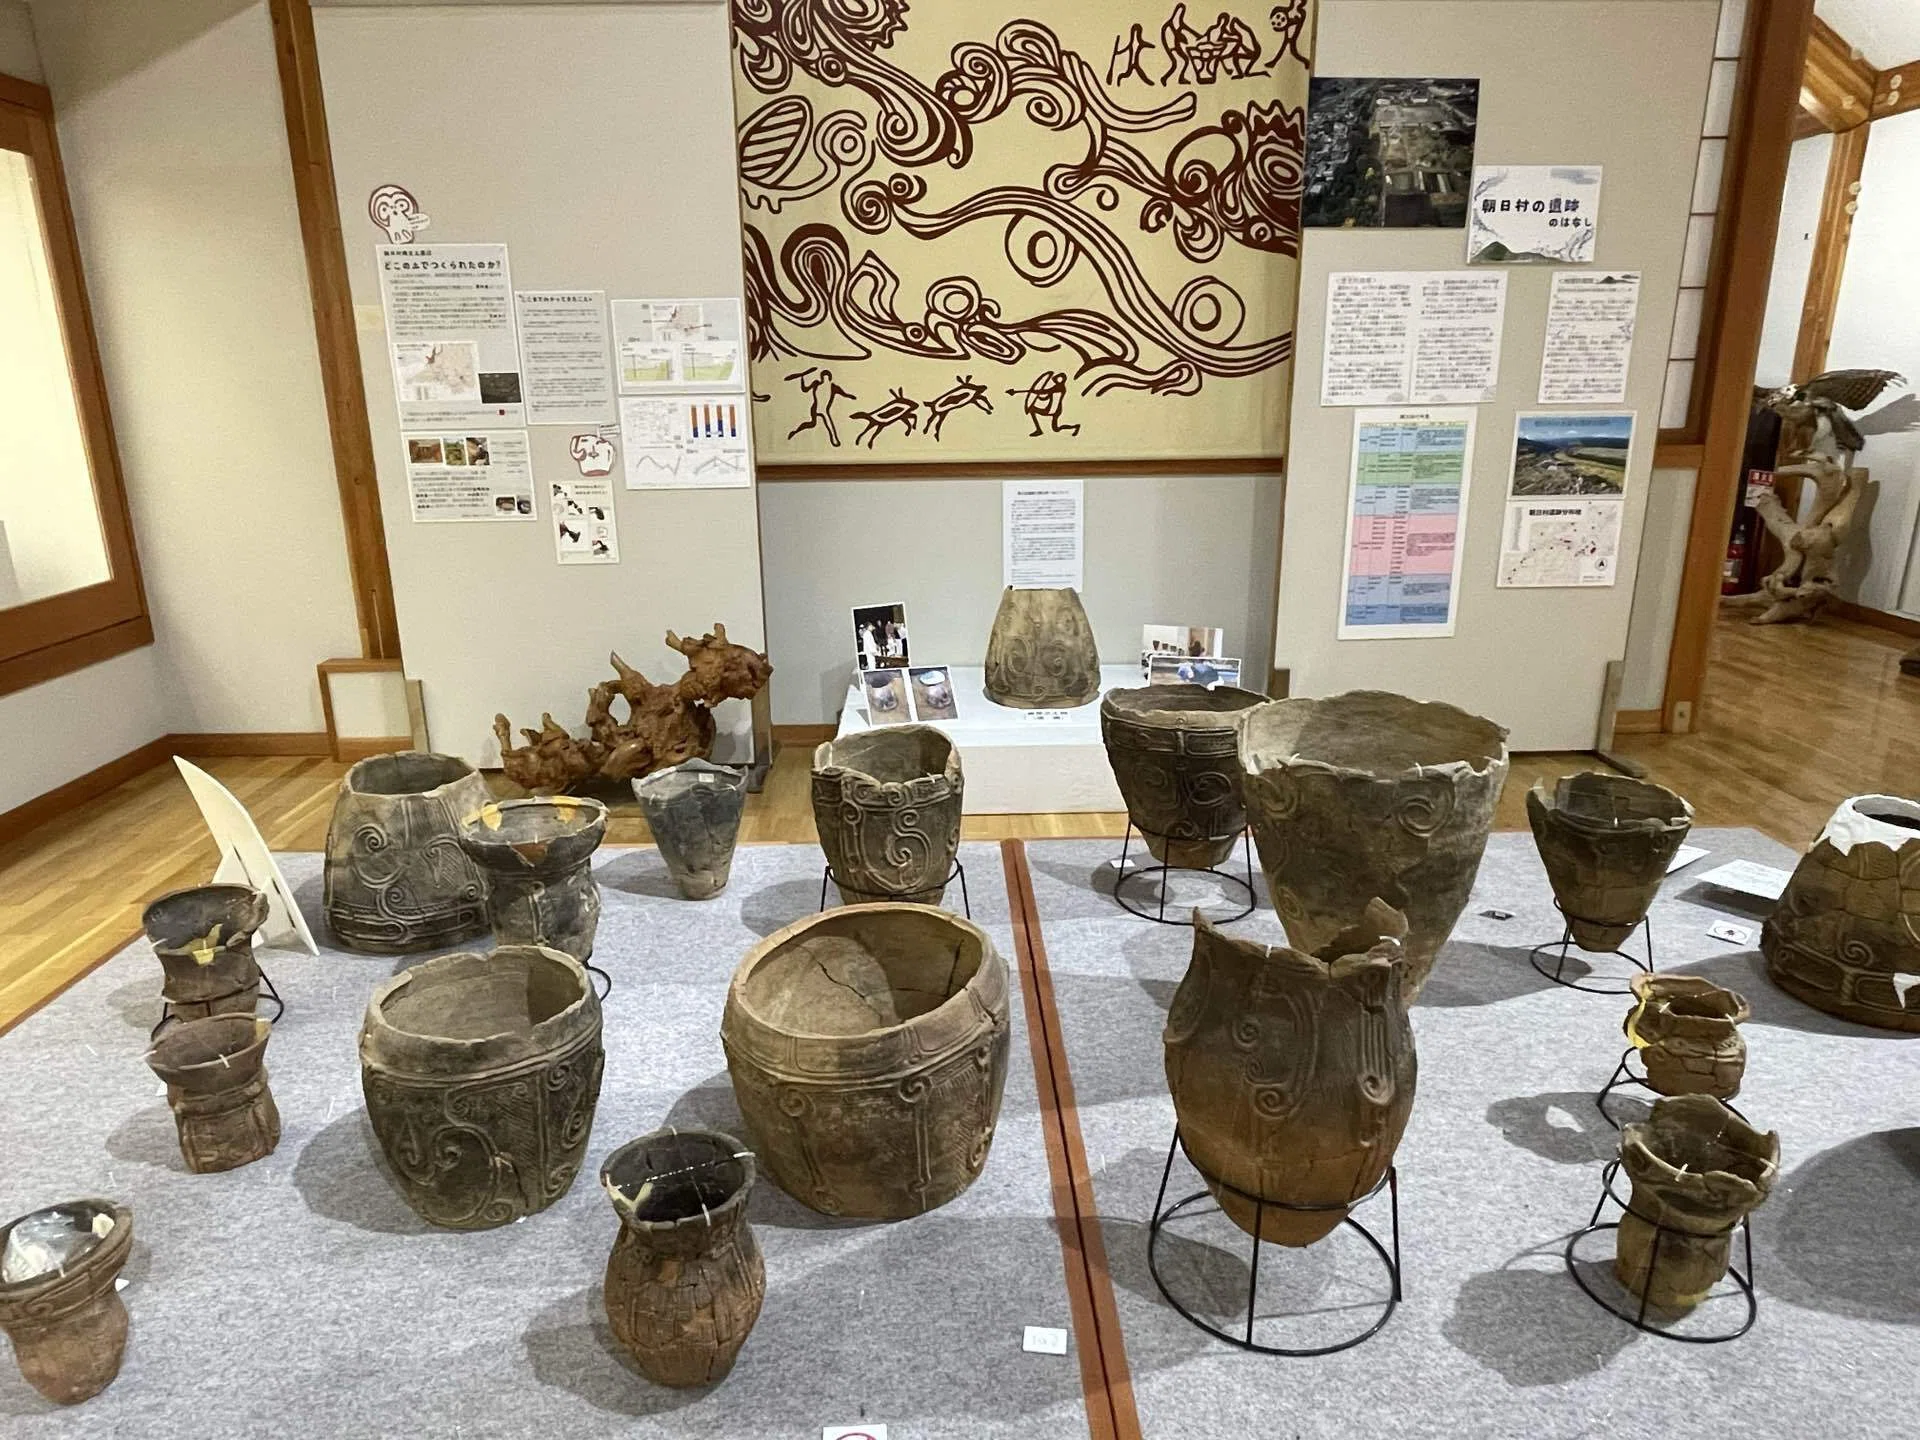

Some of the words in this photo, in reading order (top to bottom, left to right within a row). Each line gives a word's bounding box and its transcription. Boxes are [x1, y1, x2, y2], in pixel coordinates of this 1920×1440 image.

[1482, 198, 1580, 213] 朝日村の遺跡
[1548, 217, 1593, 228] のはなし
